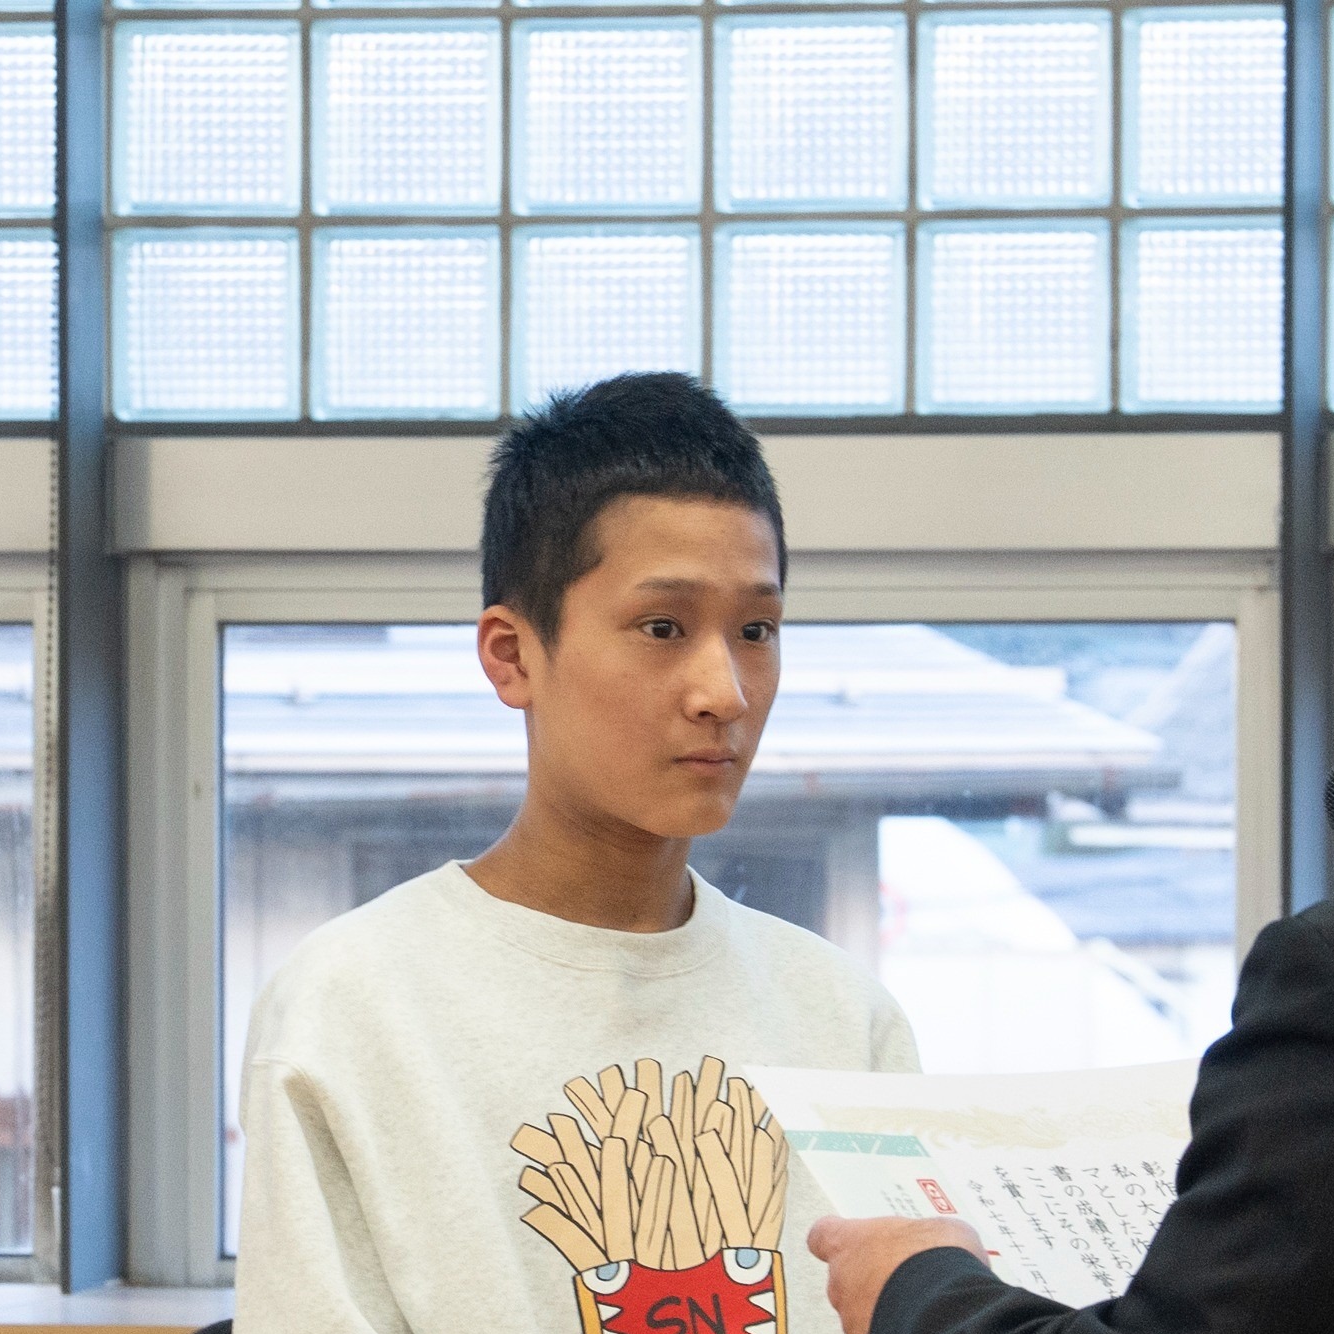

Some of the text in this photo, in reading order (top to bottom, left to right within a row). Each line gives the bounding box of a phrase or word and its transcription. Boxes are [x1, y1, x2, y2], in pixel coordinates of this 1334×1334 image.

[993, 1165, 1055, 1250] を賞します
[1049, 1165, 1137, 1279] 書の成績をお
[1141, 1160, 1177, 1207] 彰作
